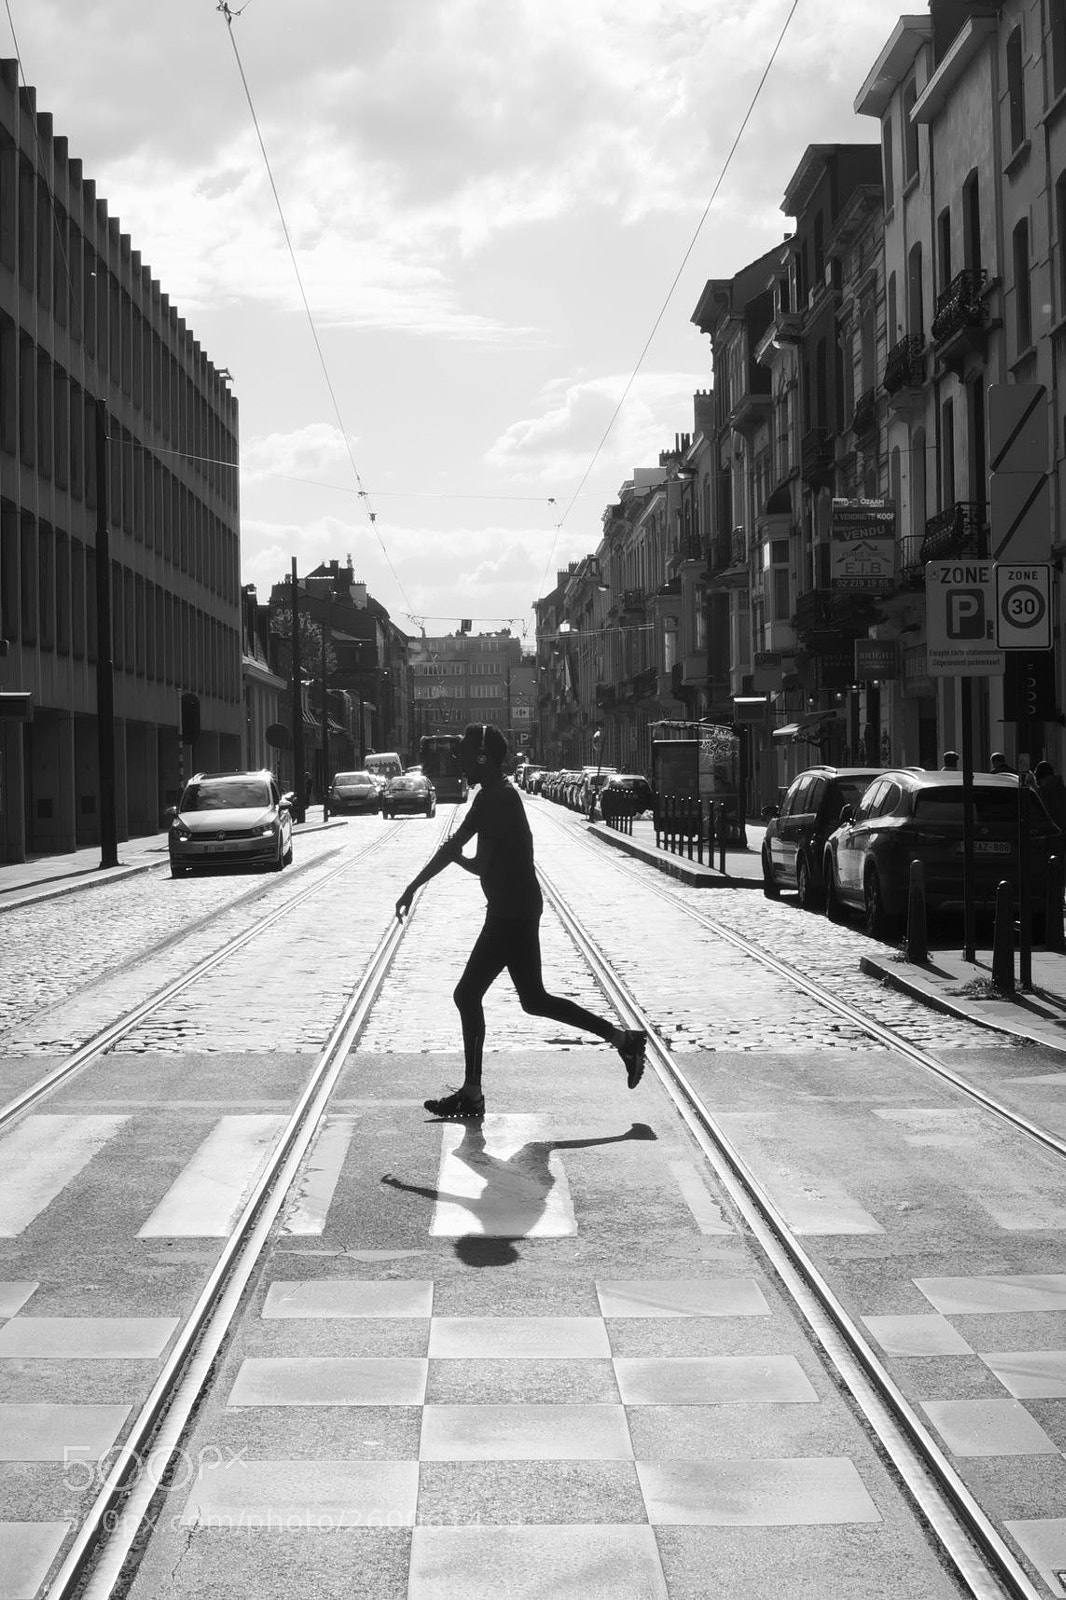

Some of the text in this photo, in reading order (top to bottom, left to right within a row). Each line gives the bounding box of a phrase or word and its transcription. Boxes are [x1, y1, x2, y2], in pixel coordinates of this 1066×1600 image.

[843, 525, 886, 540] VENDU
[940, 566, 989, 584] ZONE
[1008, 571, 1038, 580] ZONE
[952, 595, 979, 634] P
[1012, 599, 1036, 615] 30
